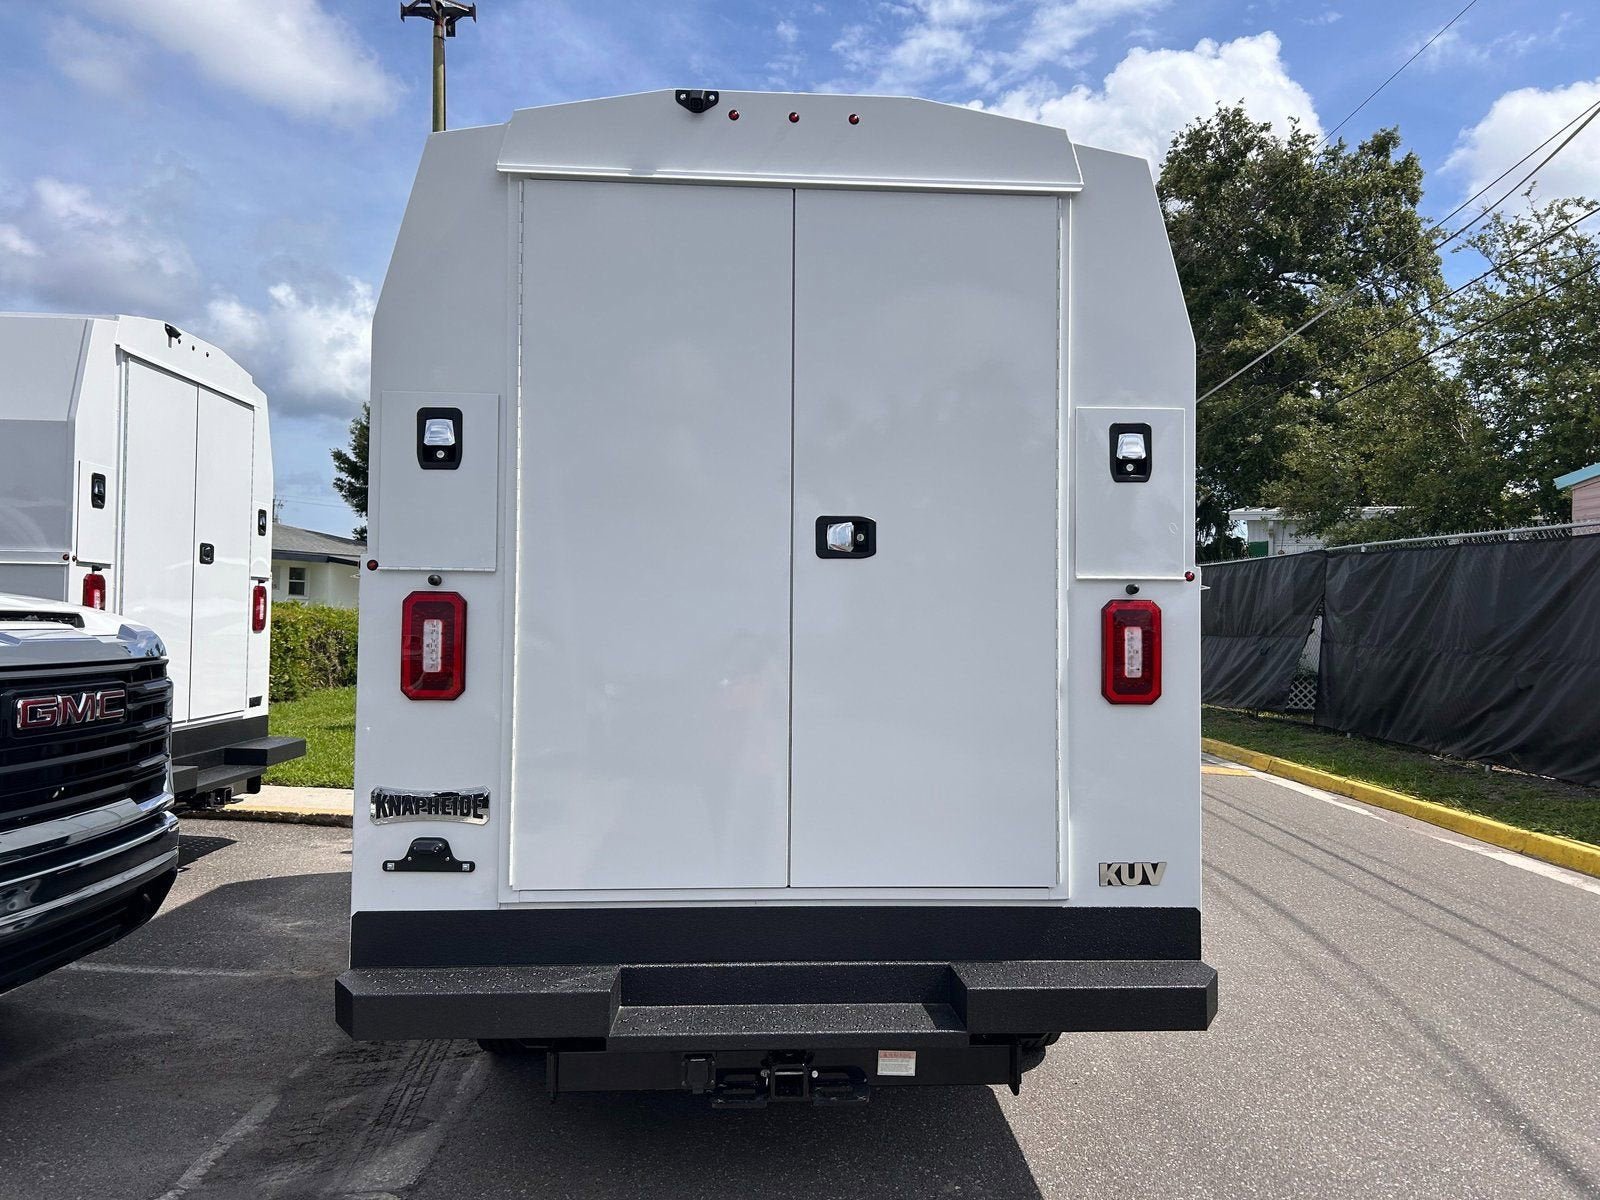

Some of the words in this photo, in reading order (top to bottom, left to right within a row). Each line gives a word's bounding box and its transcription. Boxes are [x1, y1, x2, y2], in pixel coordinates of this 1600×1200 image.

[17, 689, 125, 730] GMC
[375, 791, 485, 819] KNAPHEIDE
[1099, 862, 1167, 887] KUV
